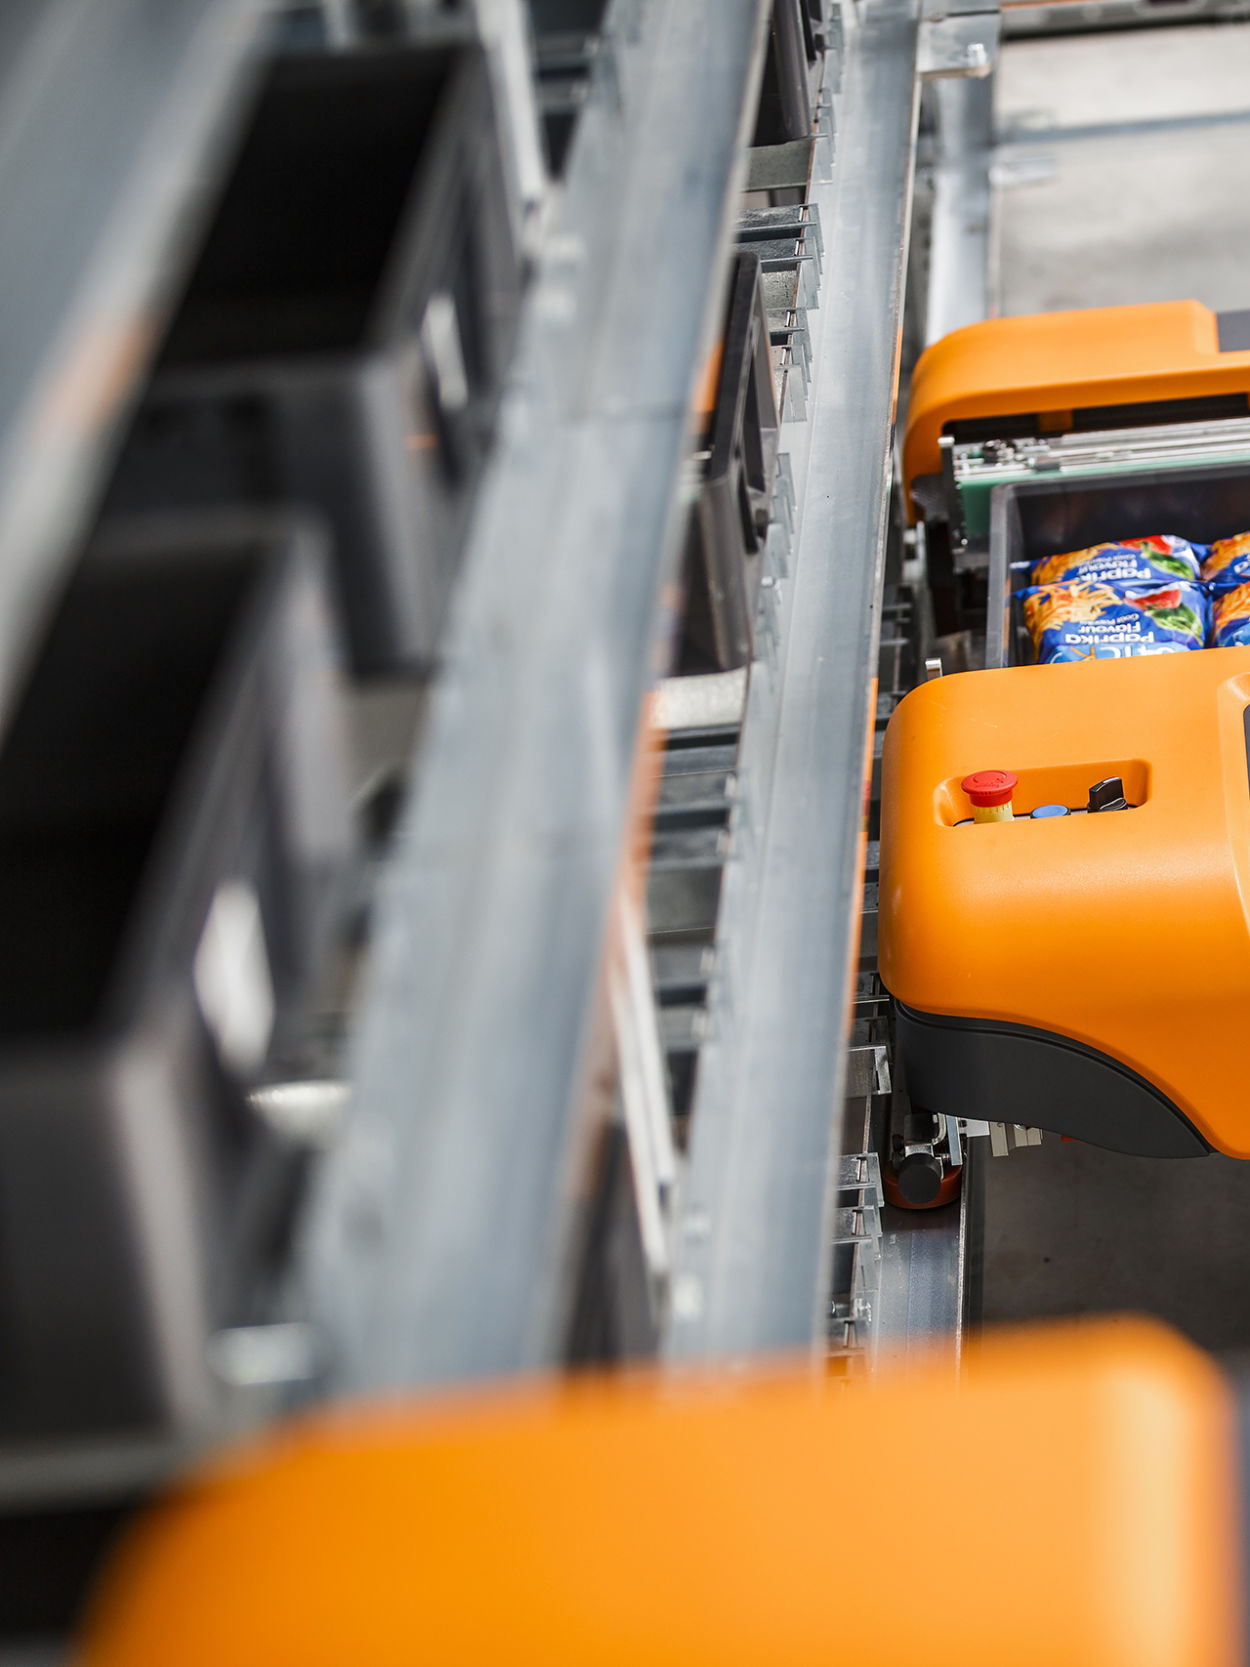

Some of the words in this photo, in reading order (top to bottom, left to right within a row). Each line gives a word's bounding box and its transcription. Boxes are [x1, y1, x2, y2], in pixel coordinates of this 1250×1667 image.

[1078, 567, 1152, 582] Paprik
[1078, 621, 1141, 633] Flavour
[1065, 631, 1155, 644] Paprika
